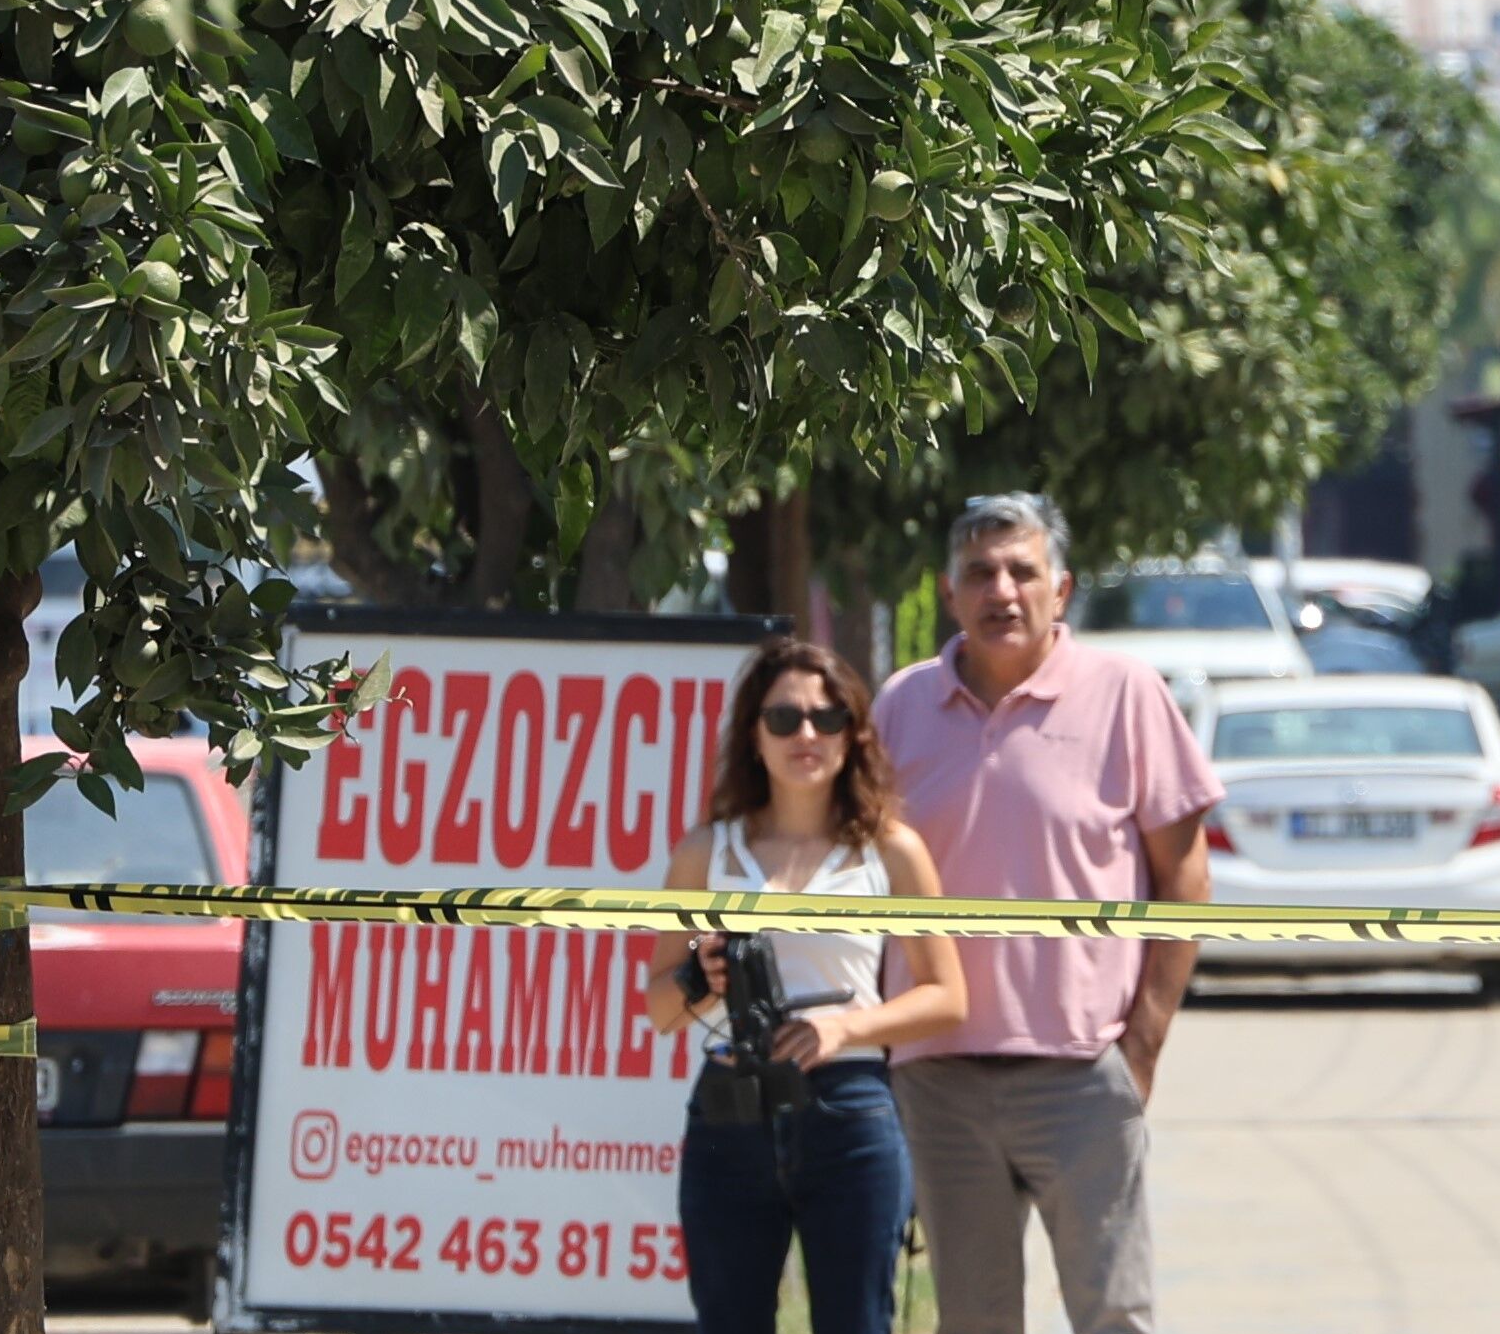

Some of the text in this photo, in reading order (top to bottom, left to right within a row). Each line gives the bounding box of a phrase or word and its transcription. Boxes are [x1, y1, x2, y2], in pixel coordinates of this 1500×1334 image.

[284, 1210, 690, 1282] 0542 463 81 53
